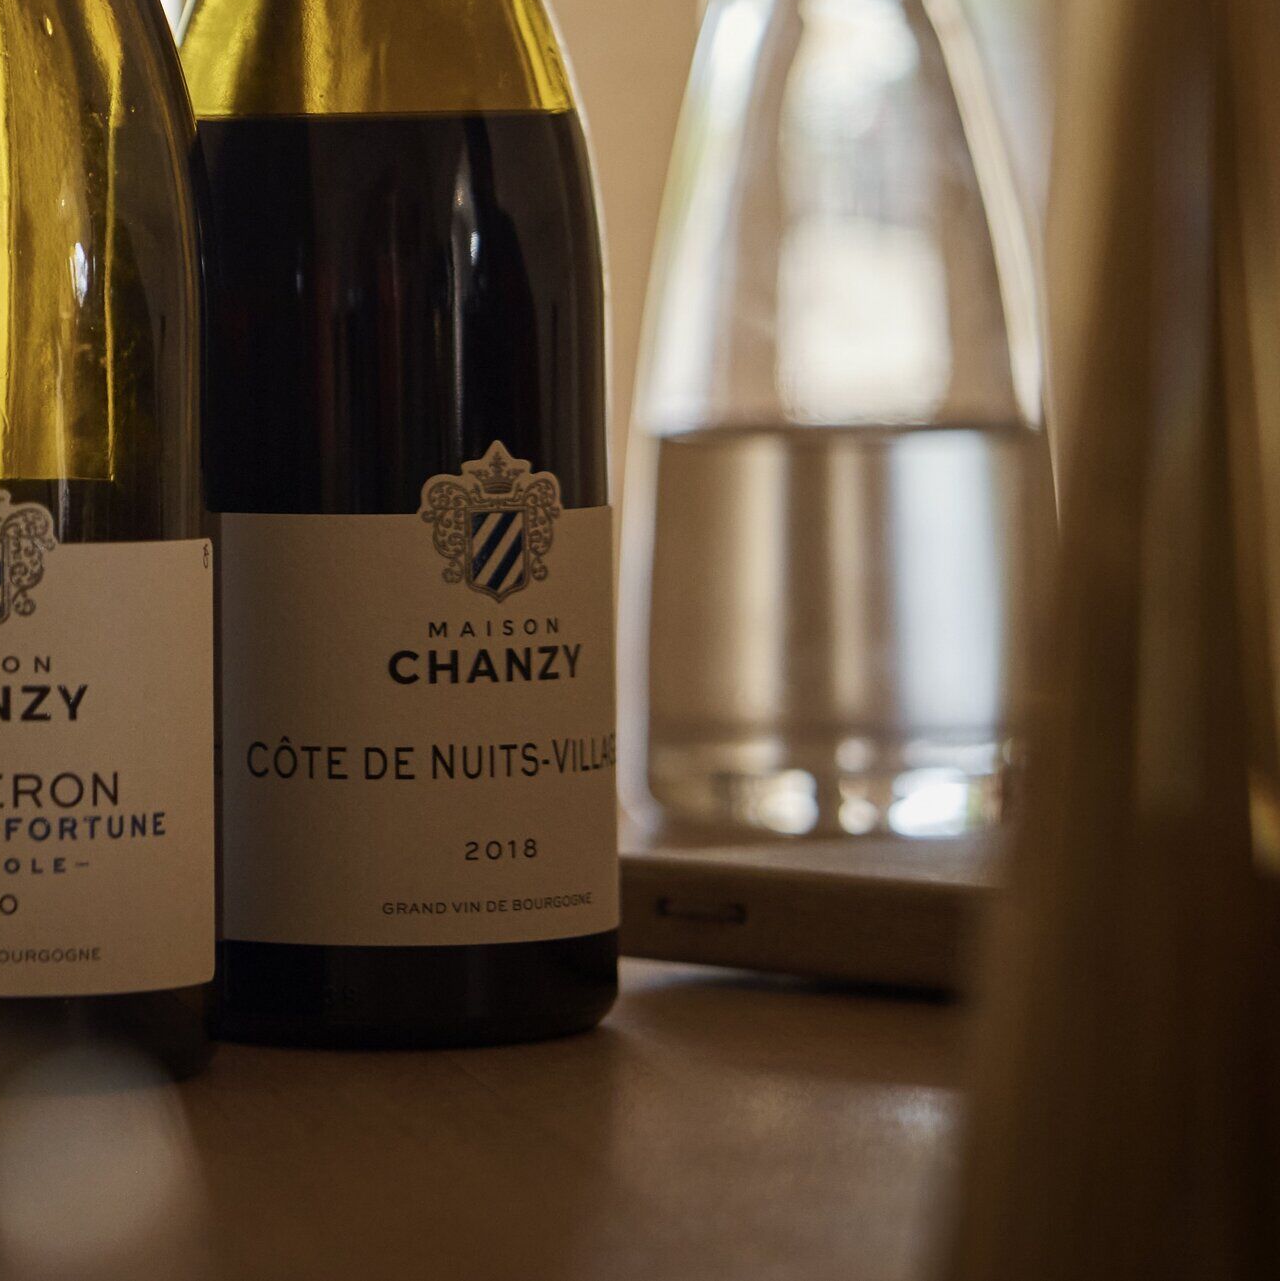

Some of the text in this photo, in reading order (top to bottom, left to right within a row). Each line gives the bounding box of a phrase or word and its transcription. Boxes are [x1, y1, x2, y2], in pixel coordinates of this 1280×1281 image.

[428, 618, 558, 638] MAISON
[388, 644, 580, 685] CHANZY
[247, 735, 348, 779] CÔTE
[364, 747, 415, 780] DE
[5, 812, 165, 842] FORTUNE
[465, 838, 537, 861] 2018
[382, 891, 593, 915] GRAND VIN DE BOURGOGNE
